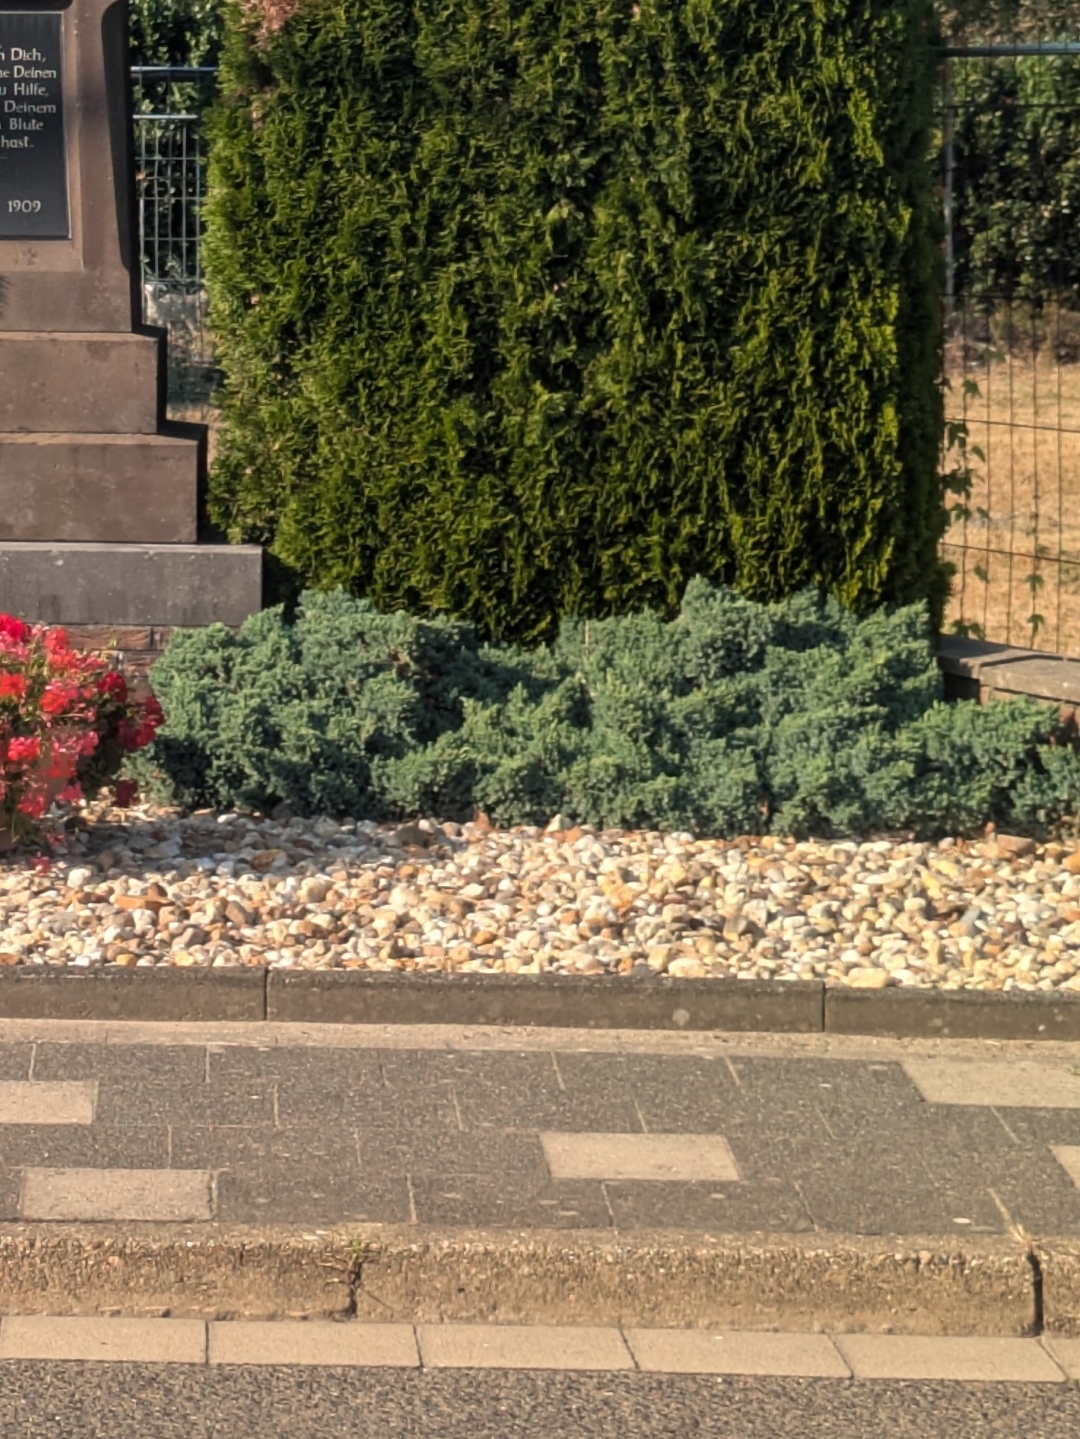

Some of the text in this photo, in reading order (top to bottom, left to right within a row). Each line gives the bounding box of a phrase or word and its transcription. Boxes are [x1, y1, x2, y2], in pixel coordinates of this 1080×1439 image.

[10, 47, 46, 62] Dich,
[13, 65, 57, 78] Deinen
[4, 100, 56, 113] Deinem
[9, 117, 44, 130] Blute
[8, 200, 41, 212] 1909
